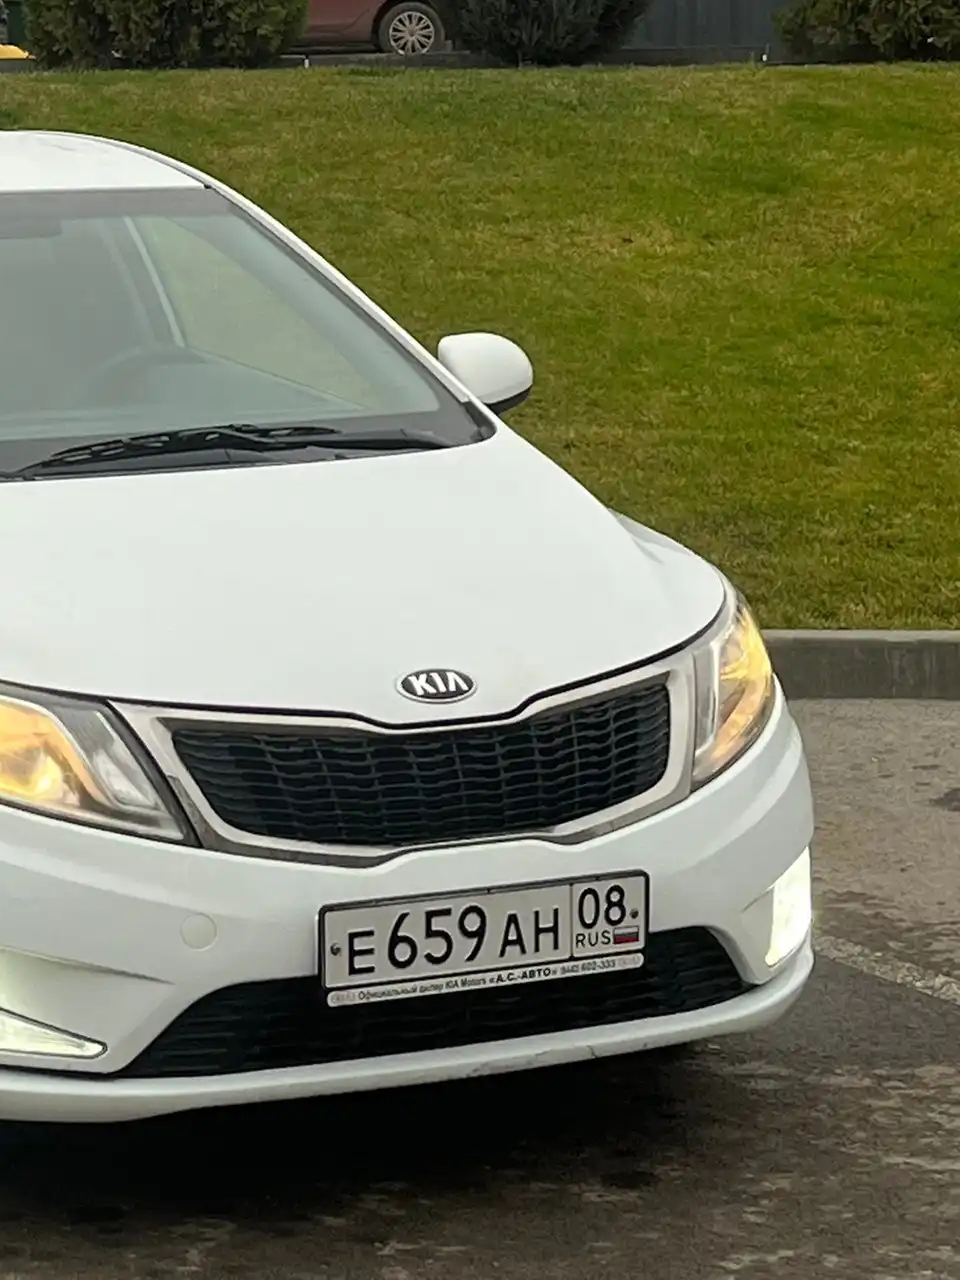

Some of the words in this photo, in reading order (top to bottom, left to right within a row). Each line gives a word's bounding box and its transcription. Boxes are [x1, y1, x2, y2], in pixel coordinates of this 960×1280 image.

[406, 670, 470, 696] KIA
[577, 884, 627, 930] 08
[575, 928, 612, 949] RUS
